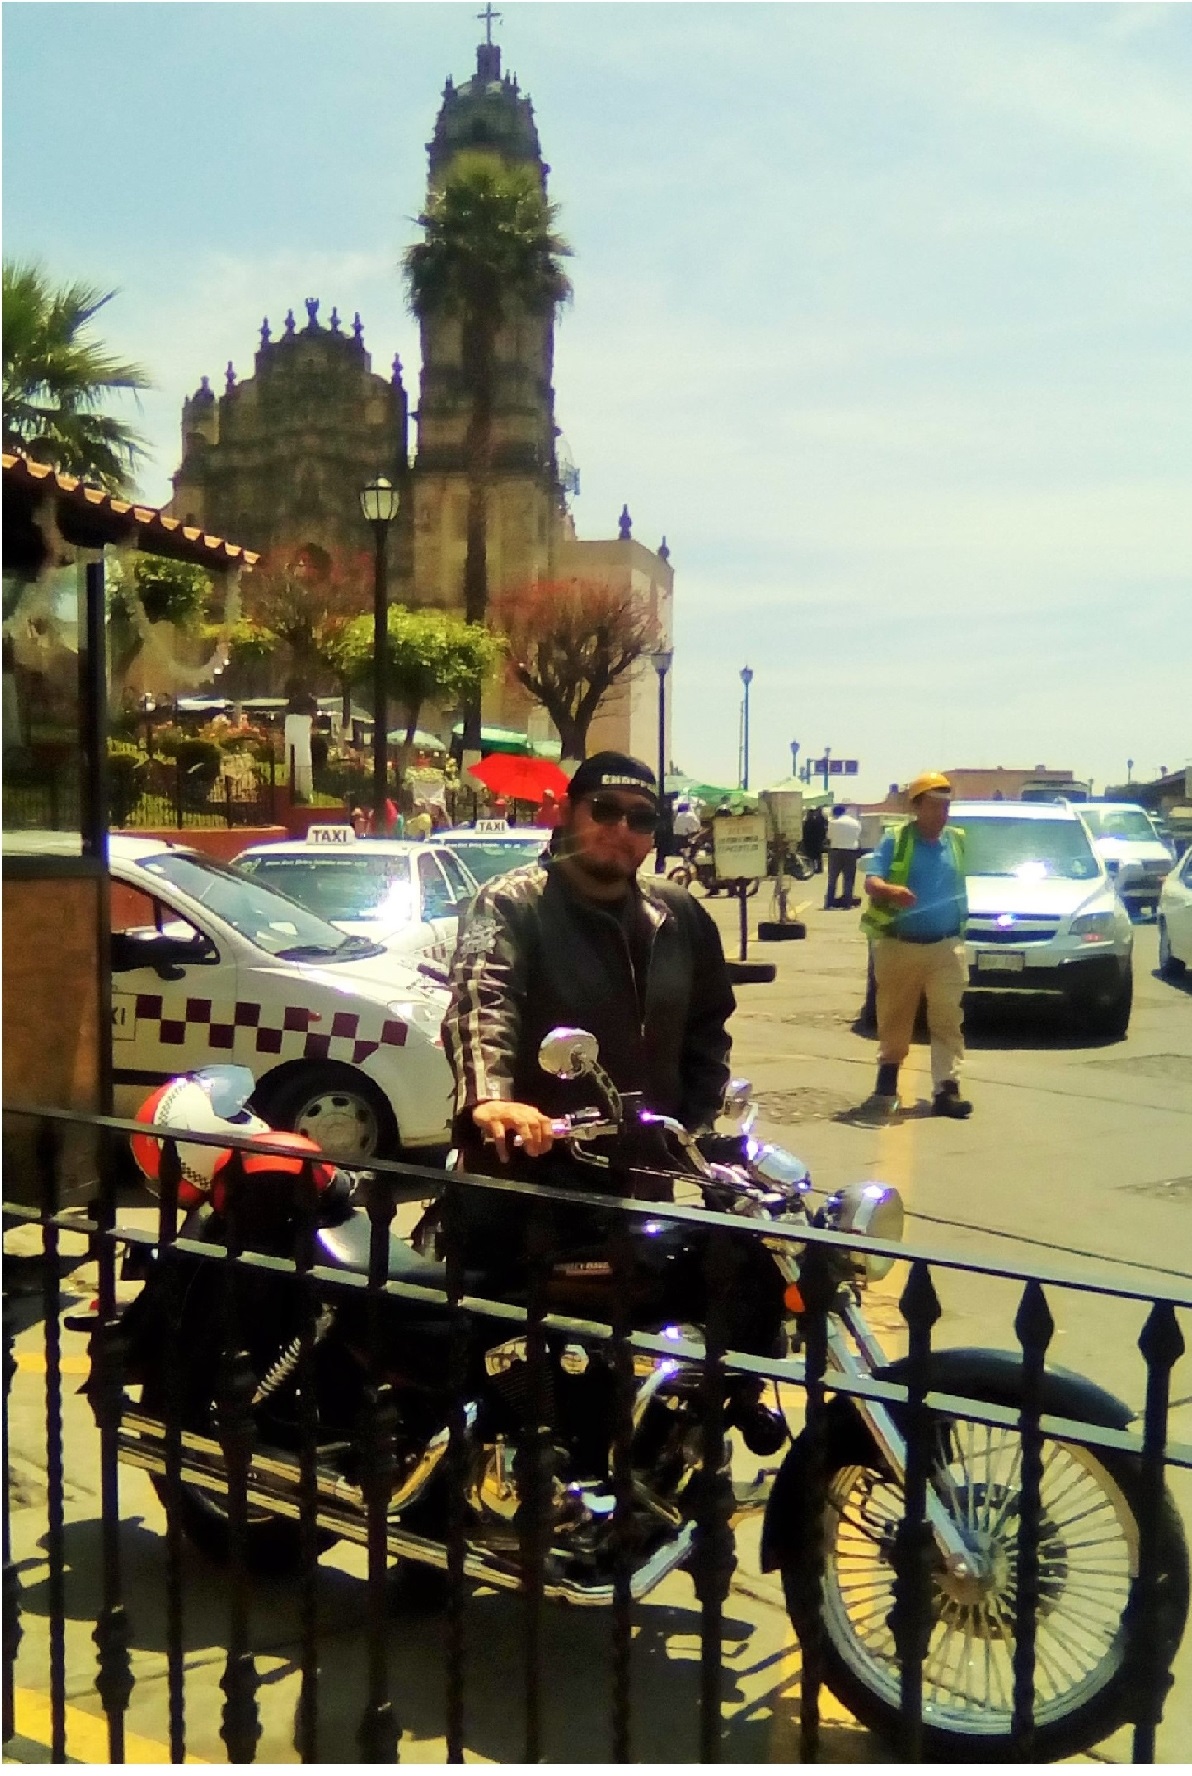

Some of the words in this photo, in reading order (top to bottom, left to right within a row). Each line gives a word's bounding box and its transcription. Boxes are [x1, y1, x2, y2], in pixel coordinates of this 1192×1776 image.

[480, 821, 505, 832] TAXI
[312, 830, 347, 843] TAXI
[111, 1006, 126, 1026] XI
